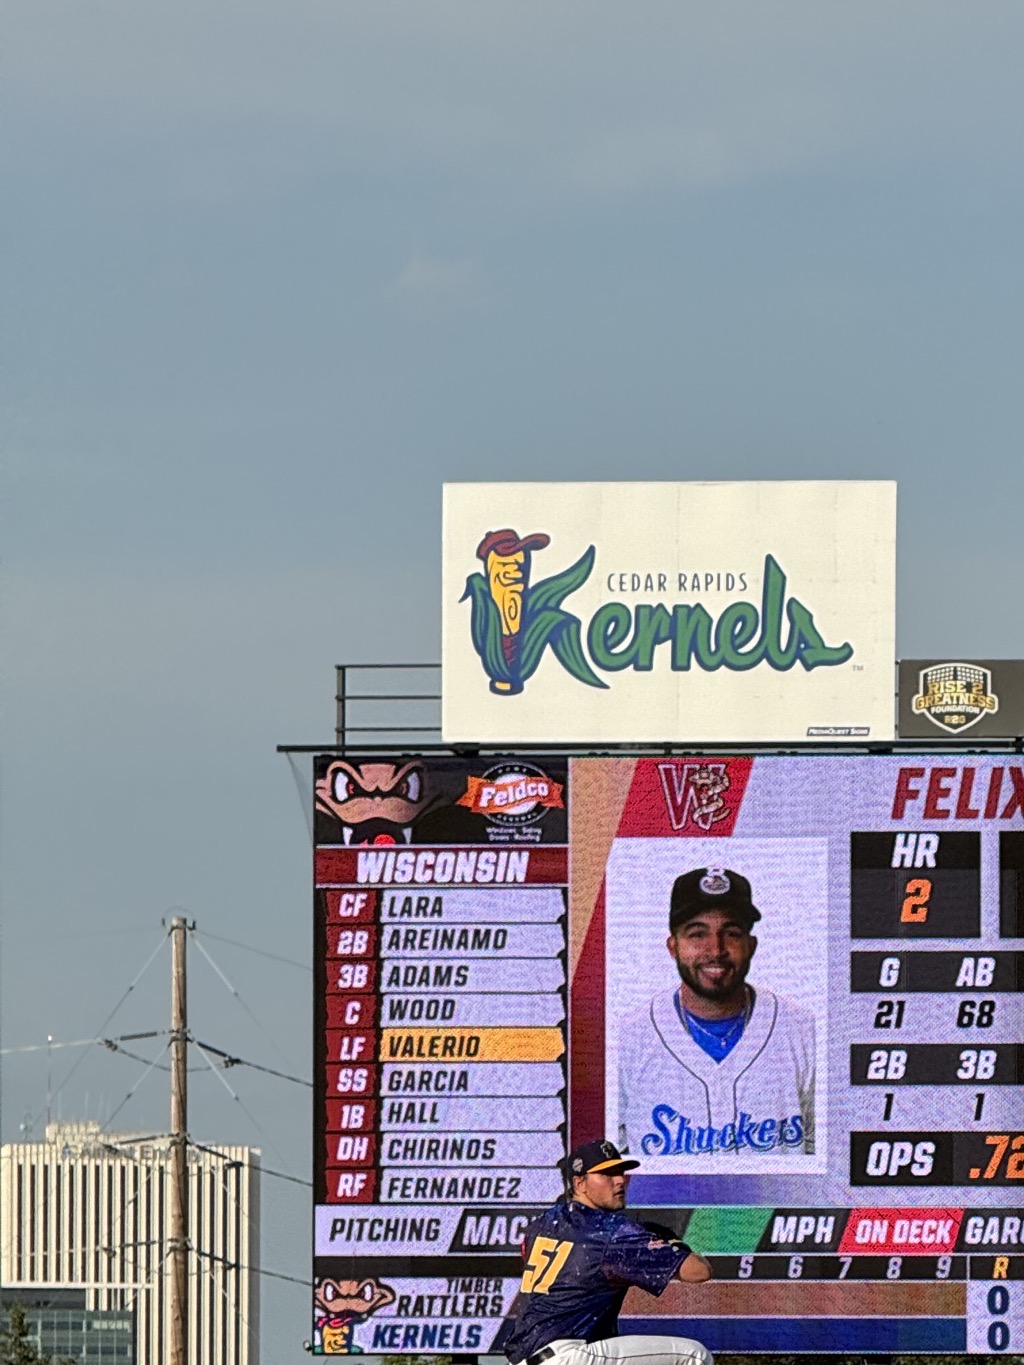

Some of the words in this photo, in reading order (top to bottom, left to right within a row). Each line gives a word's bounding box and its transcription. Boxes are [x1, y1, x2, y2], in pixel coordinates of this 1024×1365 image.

[607, 574, 666, 592] CEDAR
[679, 573, 748, 591] RAPIDS
[459, 528, 853, 695] Kernels
[928, 681, 966, 694] RISE
[972, 682, 984, 694] 2
[915, 693, 994, 710] GREATNESS
[930, 705, 980, 714] FOUNDATION
[479, 782, 549, 807] Feldco
[891, 834, 938, 867] HR
[357, 852, 530, 883] WISCONSIN
[338, 893, 368, 917] CF
[388, 896, 443, 917] LARA
[900, 880, 932, 923] 2
[337, 931, 368, 954] 2B
[388, 929, 507, 950] AREINAMO
[338, 964, 368, 988] 3B
[387, 965, 469, 986] ADAMS
[879, 961, 899, 986] G
[955, 960, 996, 987] AB
[344, 1001, 361, 1025] C
[389, 999, 456, 1020] WOOD
[874, 1001, 905, 1028] 21
[956, 1001, 995, 1028] 68
[339, 1036, 366, 1061] LF
[389, 1036, 480, 1057] VALERIO
[867, 1051, 907, 1080] 2B
[957, 1051, 996, 1079] 3B
[337, 1068, 367, 1092] SS
[388, 1070, 469, 1091] GARCIA
[341, 1105, 365, 1129] 1B
[388, 1102, 440, 1123] HALL
[883, 1094, 894, 1121] 1
[974, 1093, 985, 1121] 1
[336, 1136, 369, 1160] DH
[387, 1139, 496, 1160] CHIRINOS
[866, 1142, 935, 1176] OPS
[337, 1173, 367, 1197] RF
[388, 1177, 521, 1199] FERNANDEZ
[329, 1218, 441, 1242] PITCHING
[770, 1216, 835, 1243] MPH
[855, 1218, 889, 1244] ON
[893, 1218, 953, 1244] DECK
[521, 1236, 574, 1293] 51
[738, 1255, 754, 1278] 5
[787, 1256, 803, 1278] 6
[839, 1257, 852, 1279] 7
[887, 1257, 902, 1279] 8
[936, 1256, 951, 1278] 9
[993, 1257, 1009, 1278] R
[447, 1278, 503, 1293] TIMBER
[397, 1296, 503, 1316] RATTLERS
[988, 1286, 1009, 1315] 0
[372, 1325, 482, 1348] KERNELS
[988, 1321, 1010, 1351] 0
